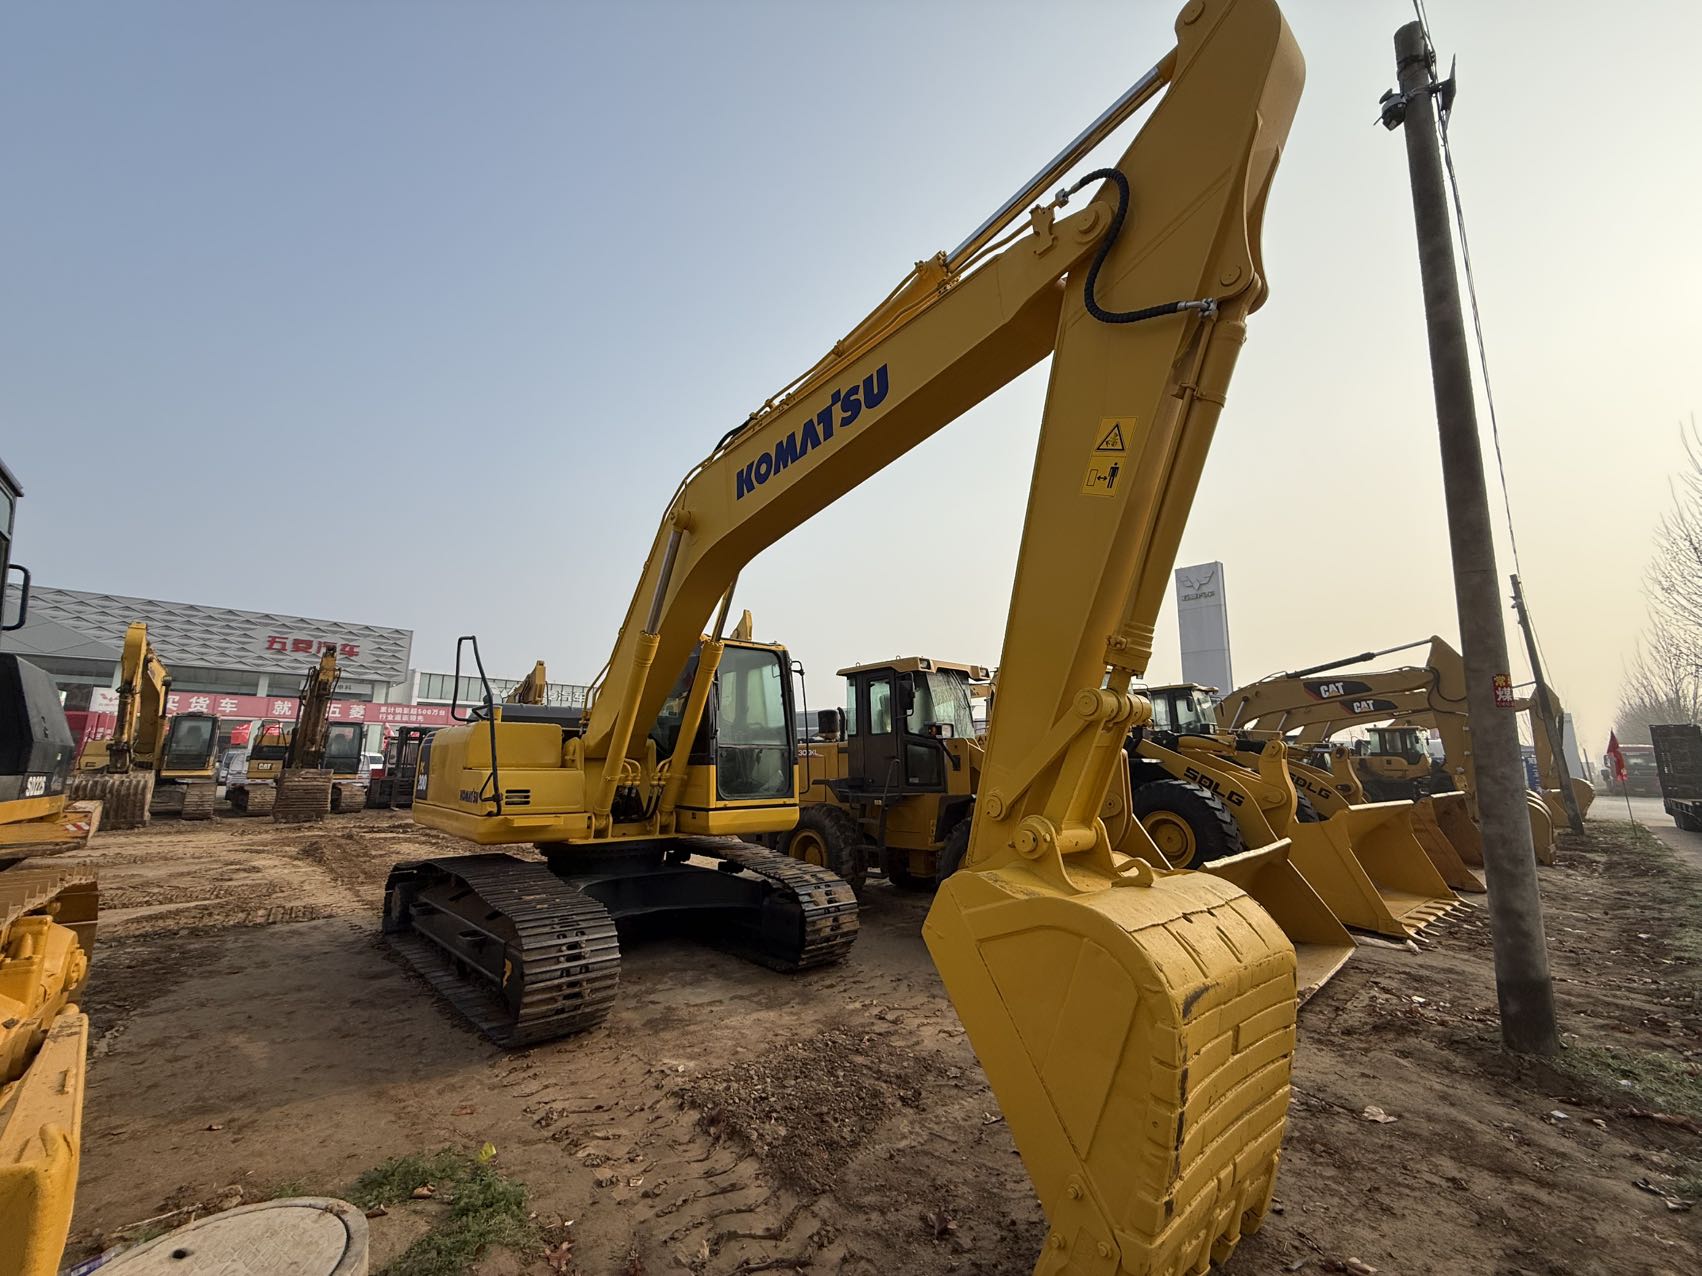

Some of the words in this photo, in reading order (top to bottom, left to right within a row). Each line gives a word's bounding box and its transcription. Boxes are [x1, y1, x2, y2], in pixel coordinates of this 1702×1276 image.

[736, 363, 889, 501] KOMATSU
[1320, 682, 1344, 699] CAT
[1353, 700, 1375, 714] CAT
[1183, 766, 1245, 807] SDLG
